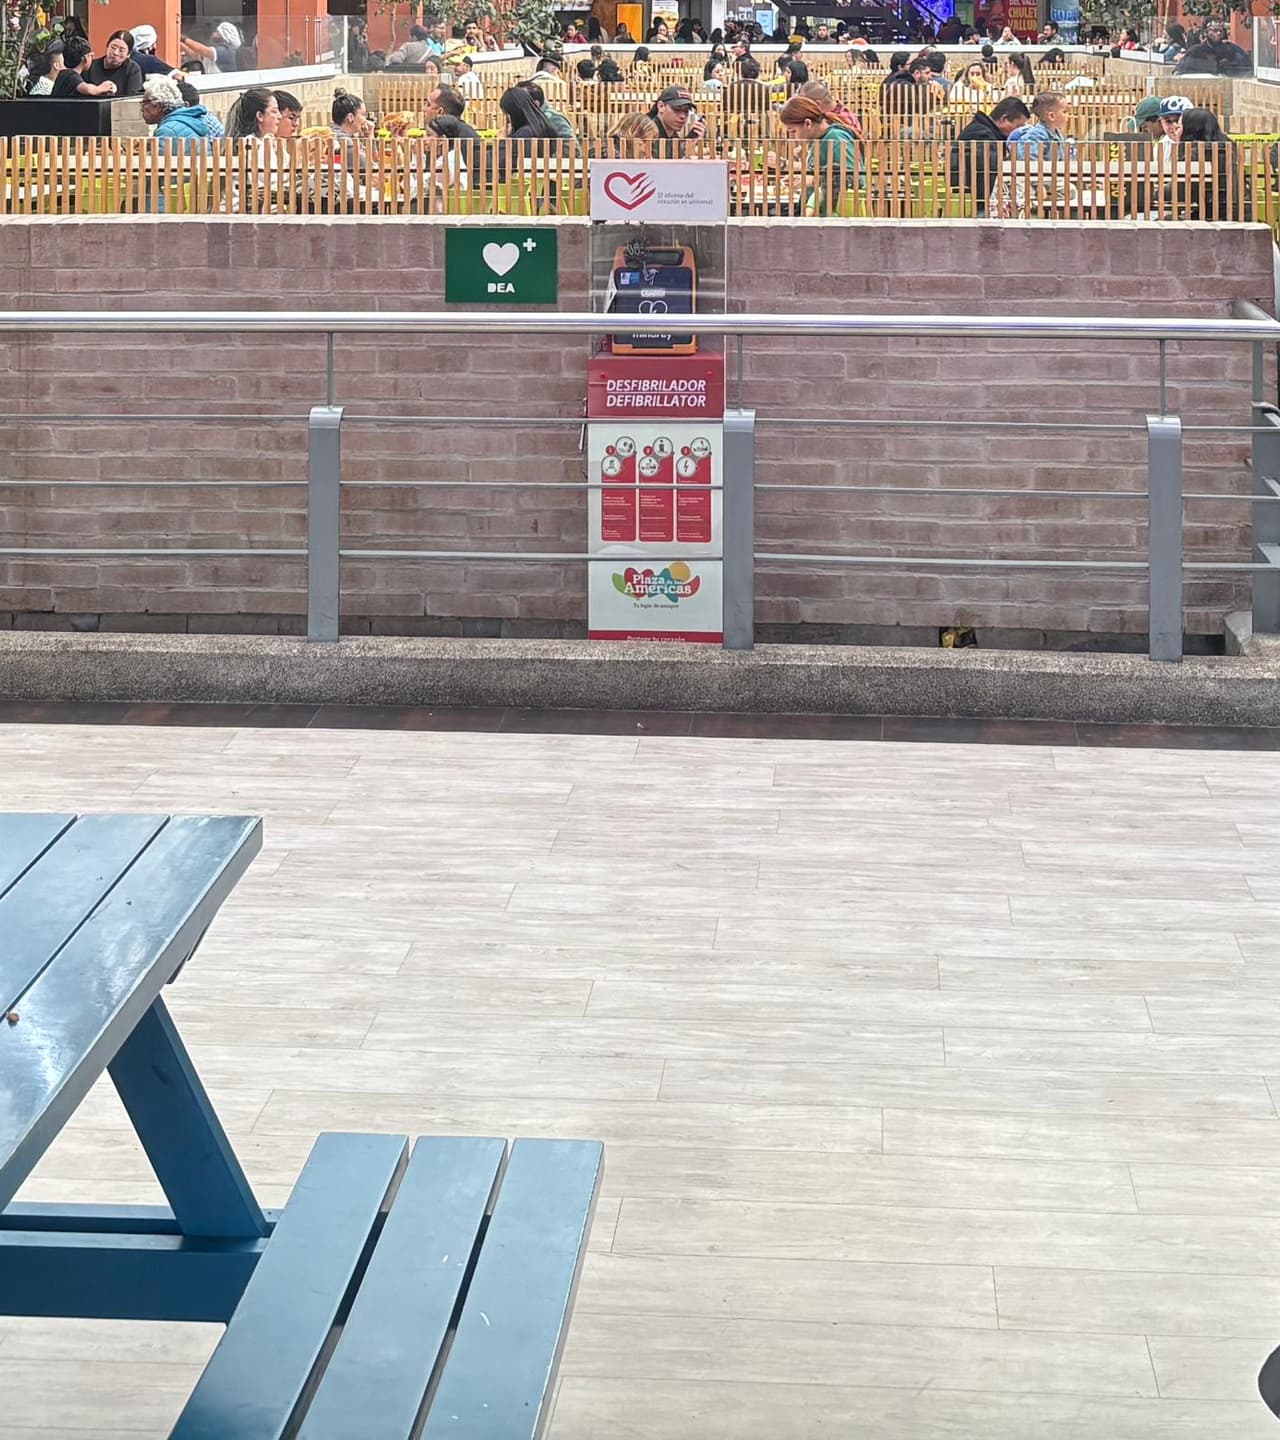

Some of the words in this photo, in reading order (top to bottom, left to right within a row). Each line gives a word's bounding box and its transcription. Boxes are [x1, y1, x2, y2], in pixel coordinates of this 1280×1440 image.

[487, 282, 516, 293] DEA
[606, 379, 707, 391] DESFIBRILADOR
[606, 394, 707, 407] DEFIBRILLATOR
[632, 573, 665, 585] Plaza
